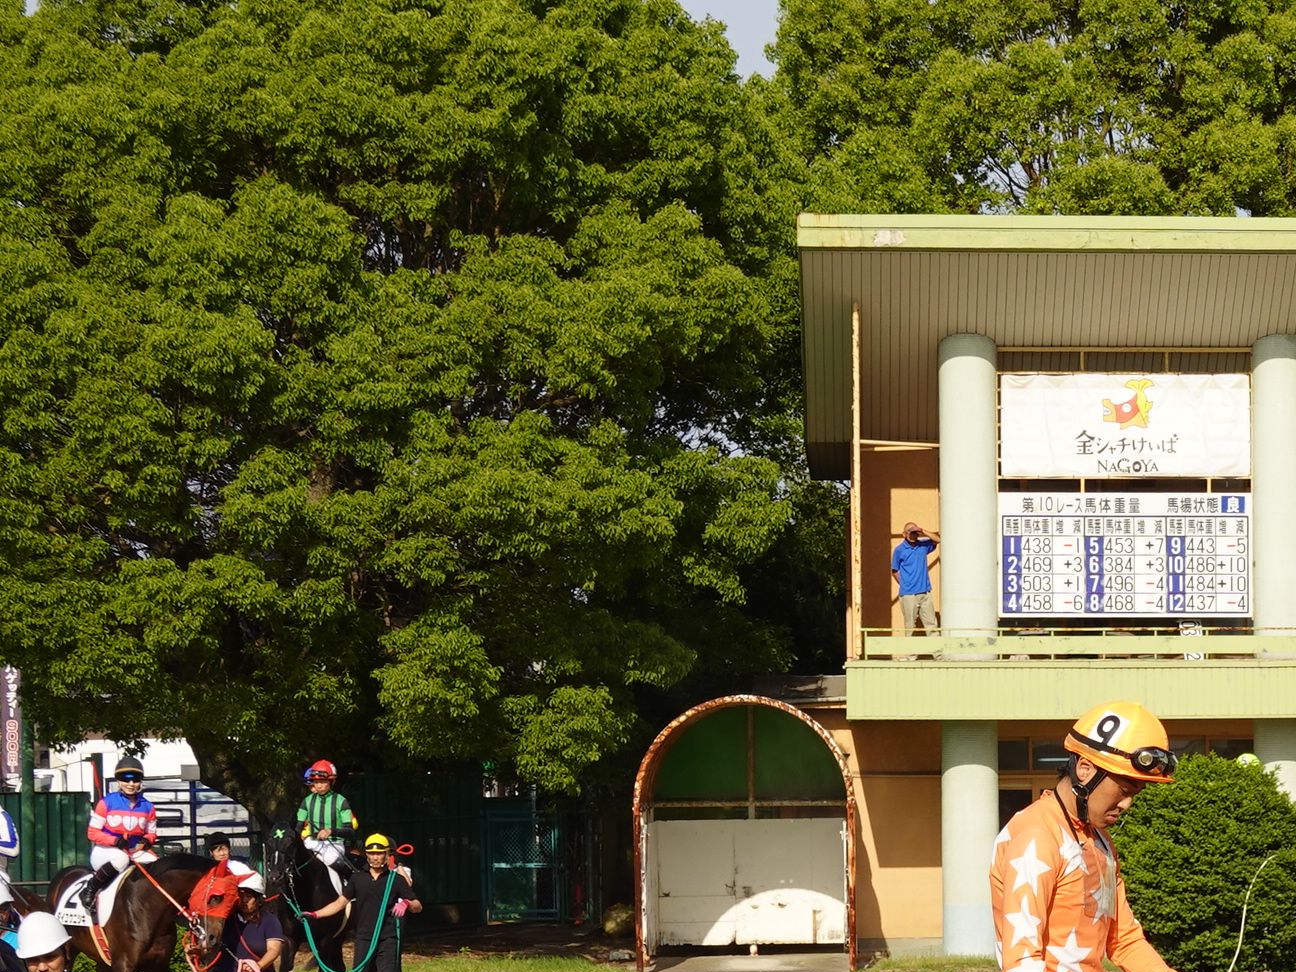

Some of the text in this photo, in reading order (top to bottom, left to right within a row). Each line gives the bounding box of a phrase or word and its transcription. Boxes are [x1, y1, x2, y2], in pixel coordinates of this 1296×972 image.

[1074, 429, 1179, 455] 金シャチけいば
[1097, 457, 1159, 473] NAGOYA
[1167, 497, 1219, 513] 馬場状態
[1010, 537, 1015, 554] 1
[1023, 537, 1052, 554] 438
[1089, 537, 1099, 554] 5
[1105, 537, 1134, 554] 453
[1171, 537, 1181, 554] 9
[1187, 537, 1215, 554] 443
[1008, 556, 1018, 573] 2
[1023, 556, 1052, 573] 469
[1089, 556, 1099, 573] 6
[1105, 556, 1134, 573] 384
[1168, 556, 1184, 573] 10
[1187, 556, 1215, 573] 486
[1008, 575, 1018, 592] 3
[1023, 575, 1052, 592] 503
[1089, 575, 1099, 592] 7
[1105, 575, 1134, 592] 496
[1168, 575, 1184, 592] 11
[1187, 575, 1215, 592] 484
[1008, 594, 1018, 611] 4
[1023, 594, 1052, 611] 458
[1089, 594, 1099, 611] 8
[1105, 594, 1134, 611] 468
[1168, 594, 1184, 611] 12
[1187, 594, 1215, 611] 437
[1096, 715, 1121, 745] 9
[64, 879, 87, 909] 2
